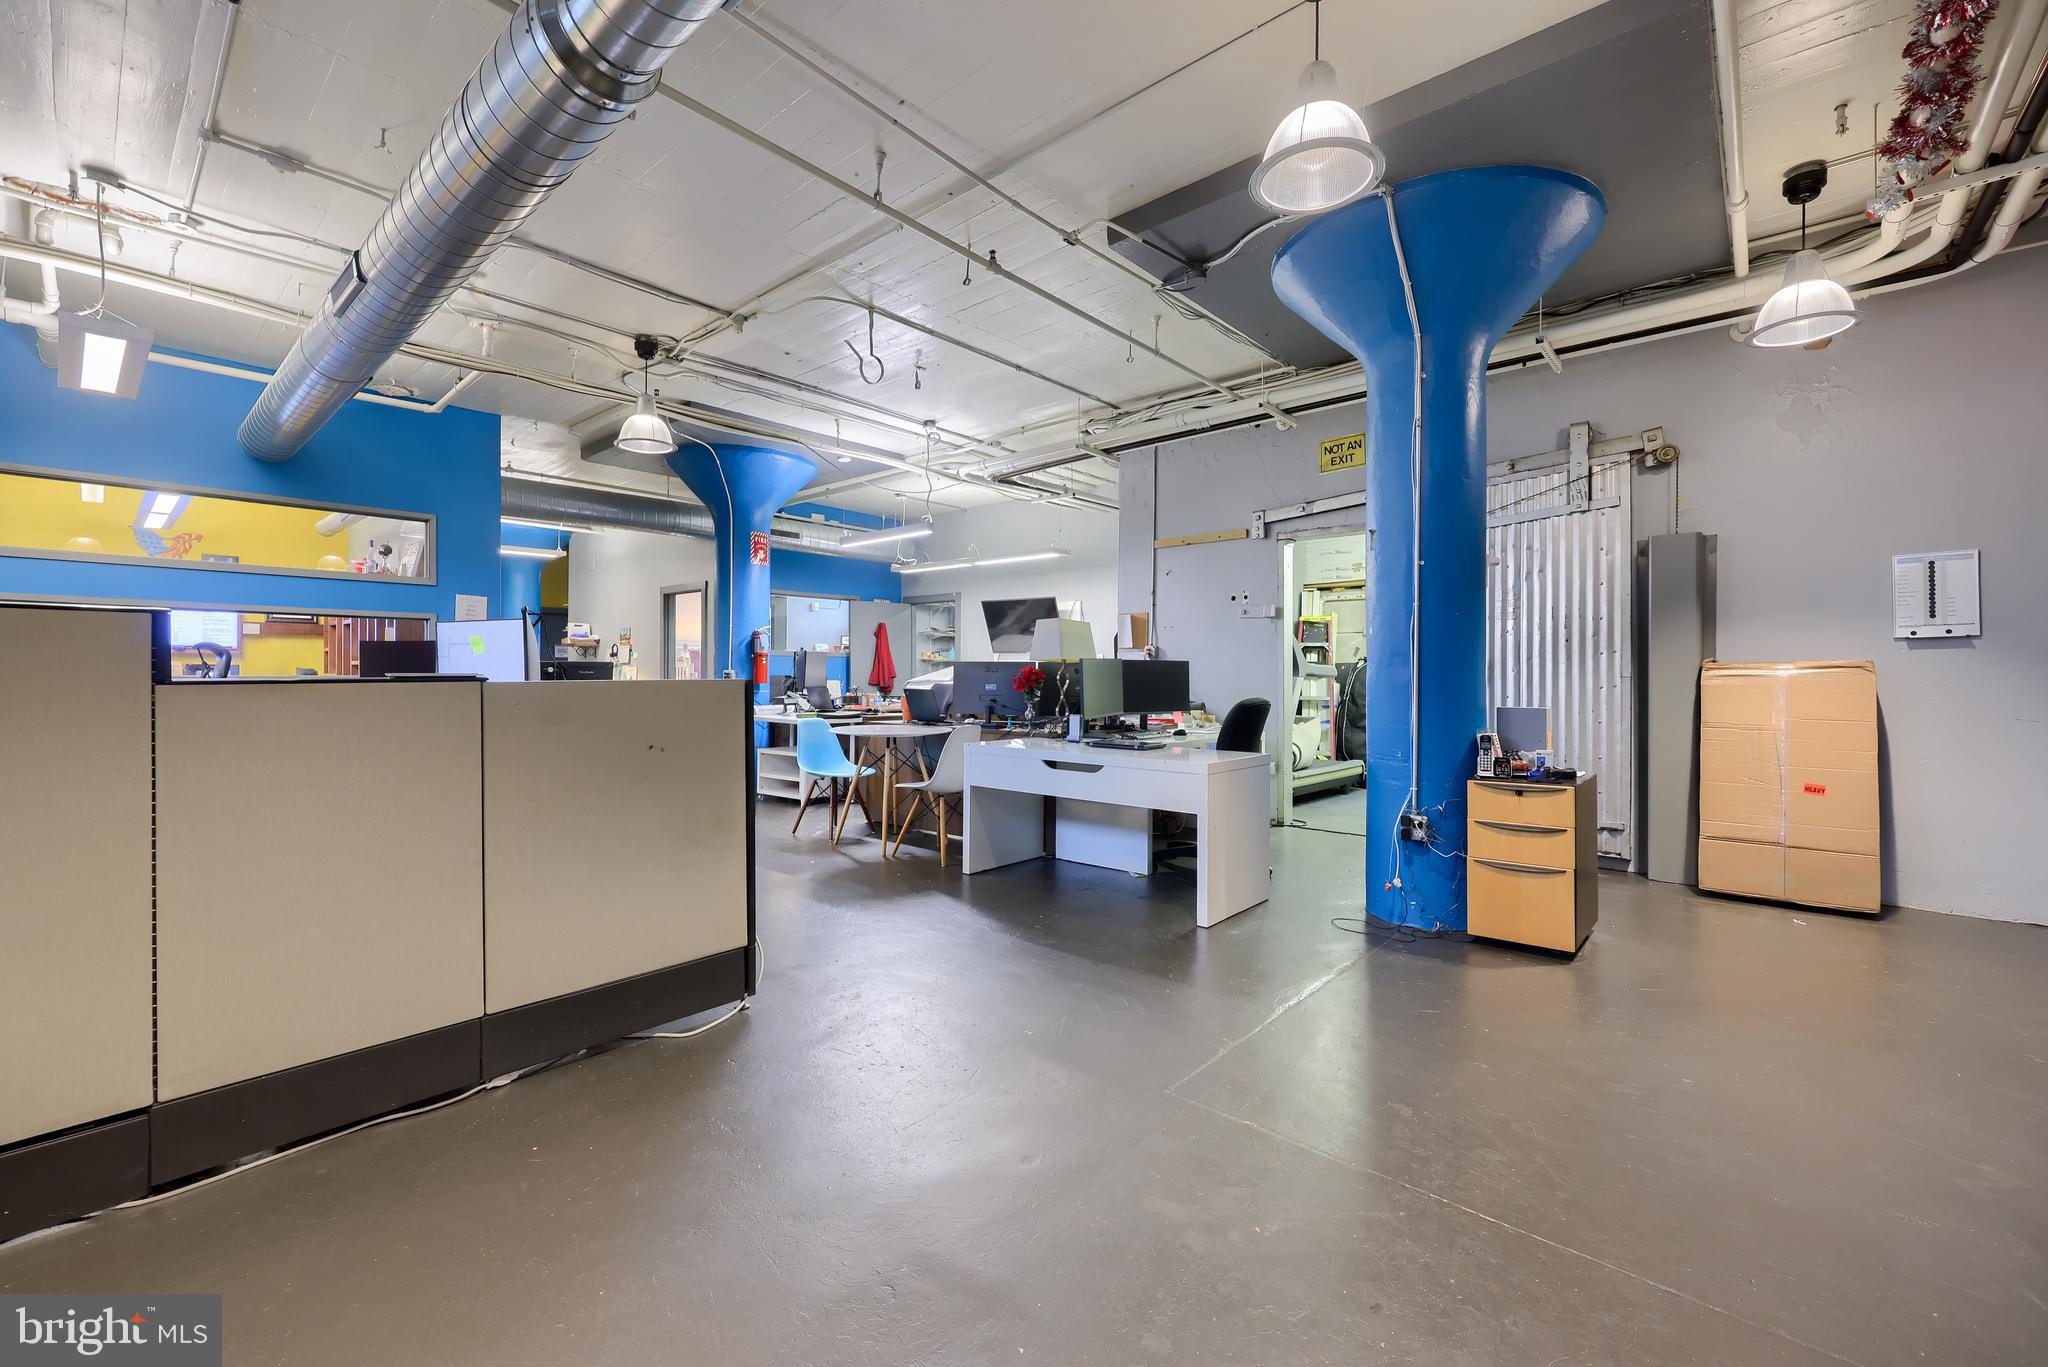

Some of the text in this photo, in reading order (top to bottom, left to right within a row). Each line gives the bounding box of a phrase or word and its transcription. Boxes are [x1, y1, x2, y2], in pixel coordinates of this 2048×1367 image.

[1324, 439, 1362, 455] NOT AN
[1330, 453, 1355, 466] EXIT
[1804, 786, 1826, 794] HEAVY
